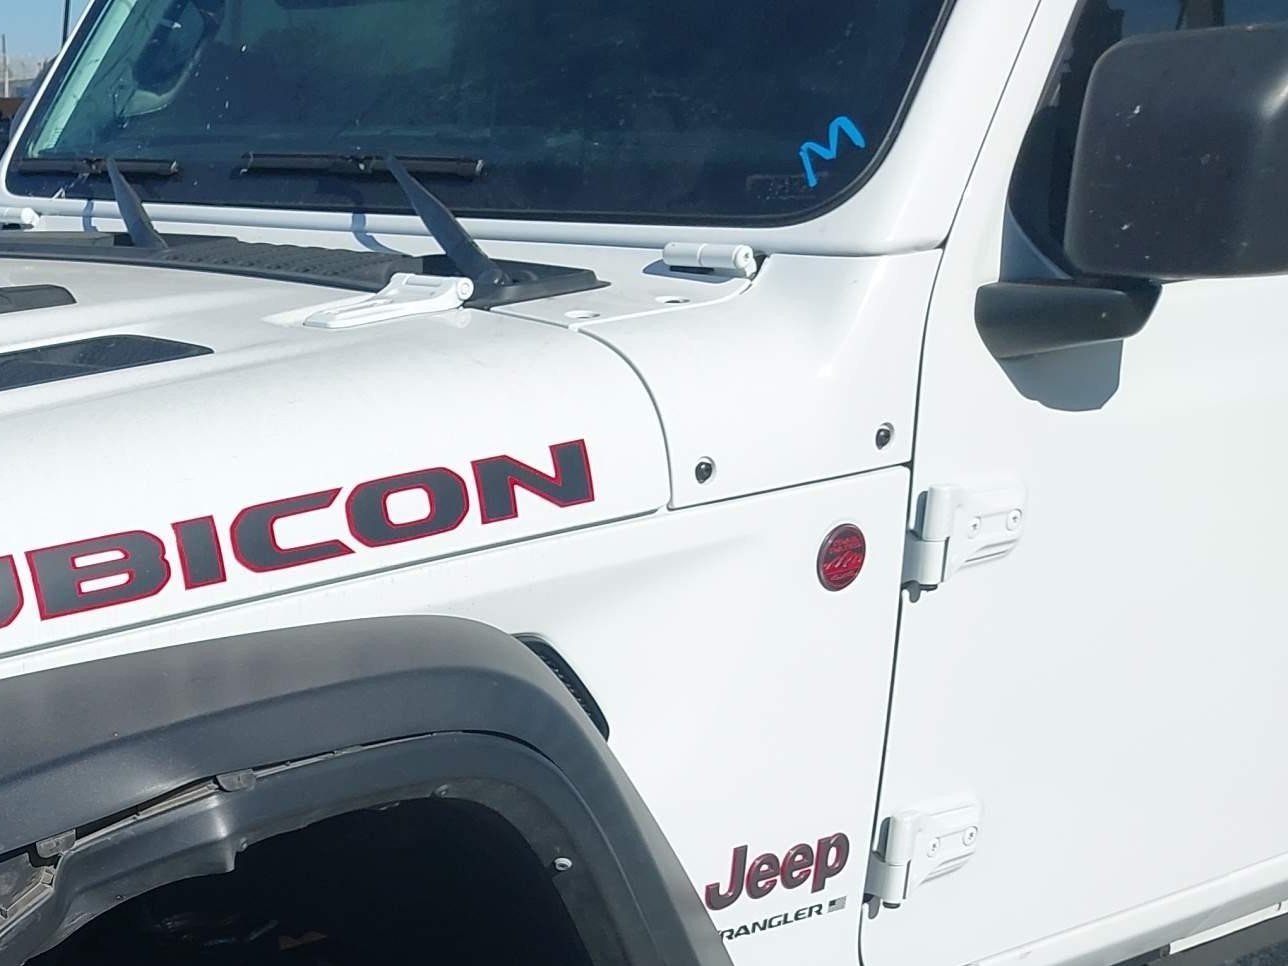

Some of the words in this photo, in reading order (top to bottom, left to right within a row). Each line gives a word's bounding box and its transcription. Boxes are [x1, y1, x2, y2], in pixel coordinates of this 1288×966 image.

[798, 115, 866, 188] M
[705, 832, 850, 911] Jeep
[717, 903, 823, 941] RANGLER
